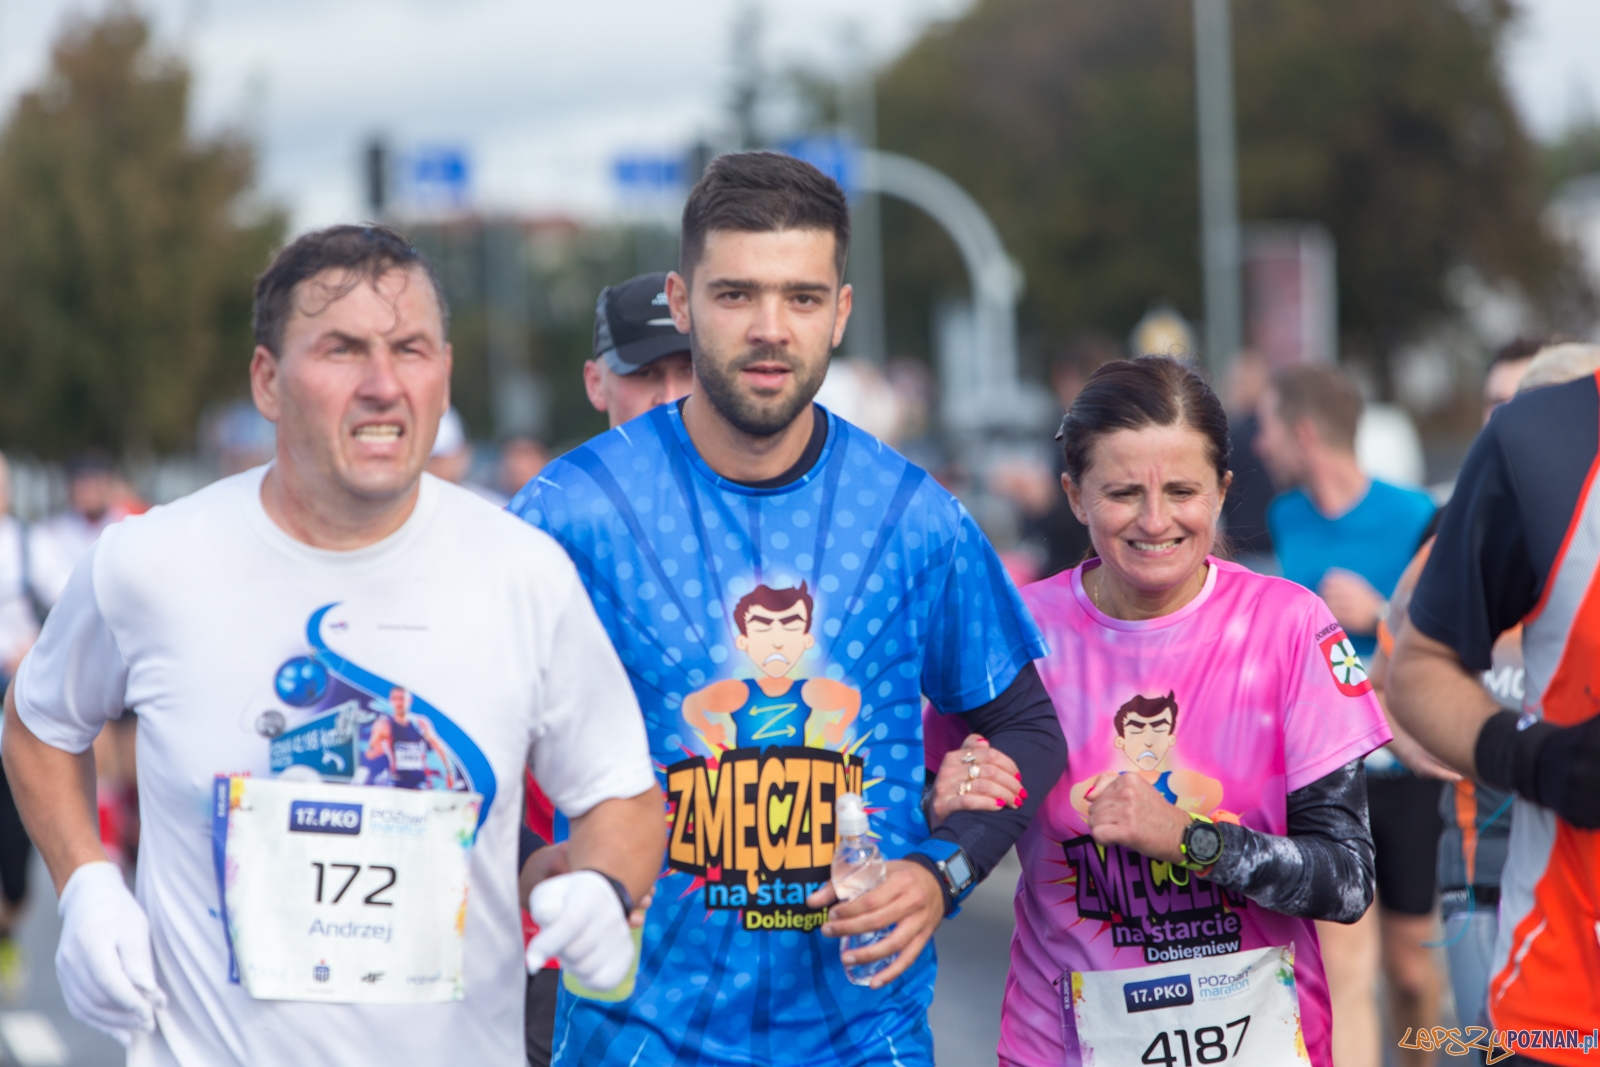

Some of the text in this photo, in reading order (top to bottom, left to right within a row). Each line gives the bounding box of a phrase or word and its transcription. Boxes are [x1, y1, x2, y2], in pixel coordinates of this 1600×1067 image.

[319, 808, 360, 829] PKO
[311, 861, 397, 906] 172
[709, 878, 827, 906] na star
[308, 918, 393, 944] Andrzej
[1115, 912, 1240, 944] na starcie
[1147, 940, 1240, 962] Dobiegniew
[1131, 988, 1152, 1004] 17.
[1153, 982, 1188, 1001] PKO
[1199, 978, 1250, 998] maraton
[1141, 1014, 1251, 1067] 4187
